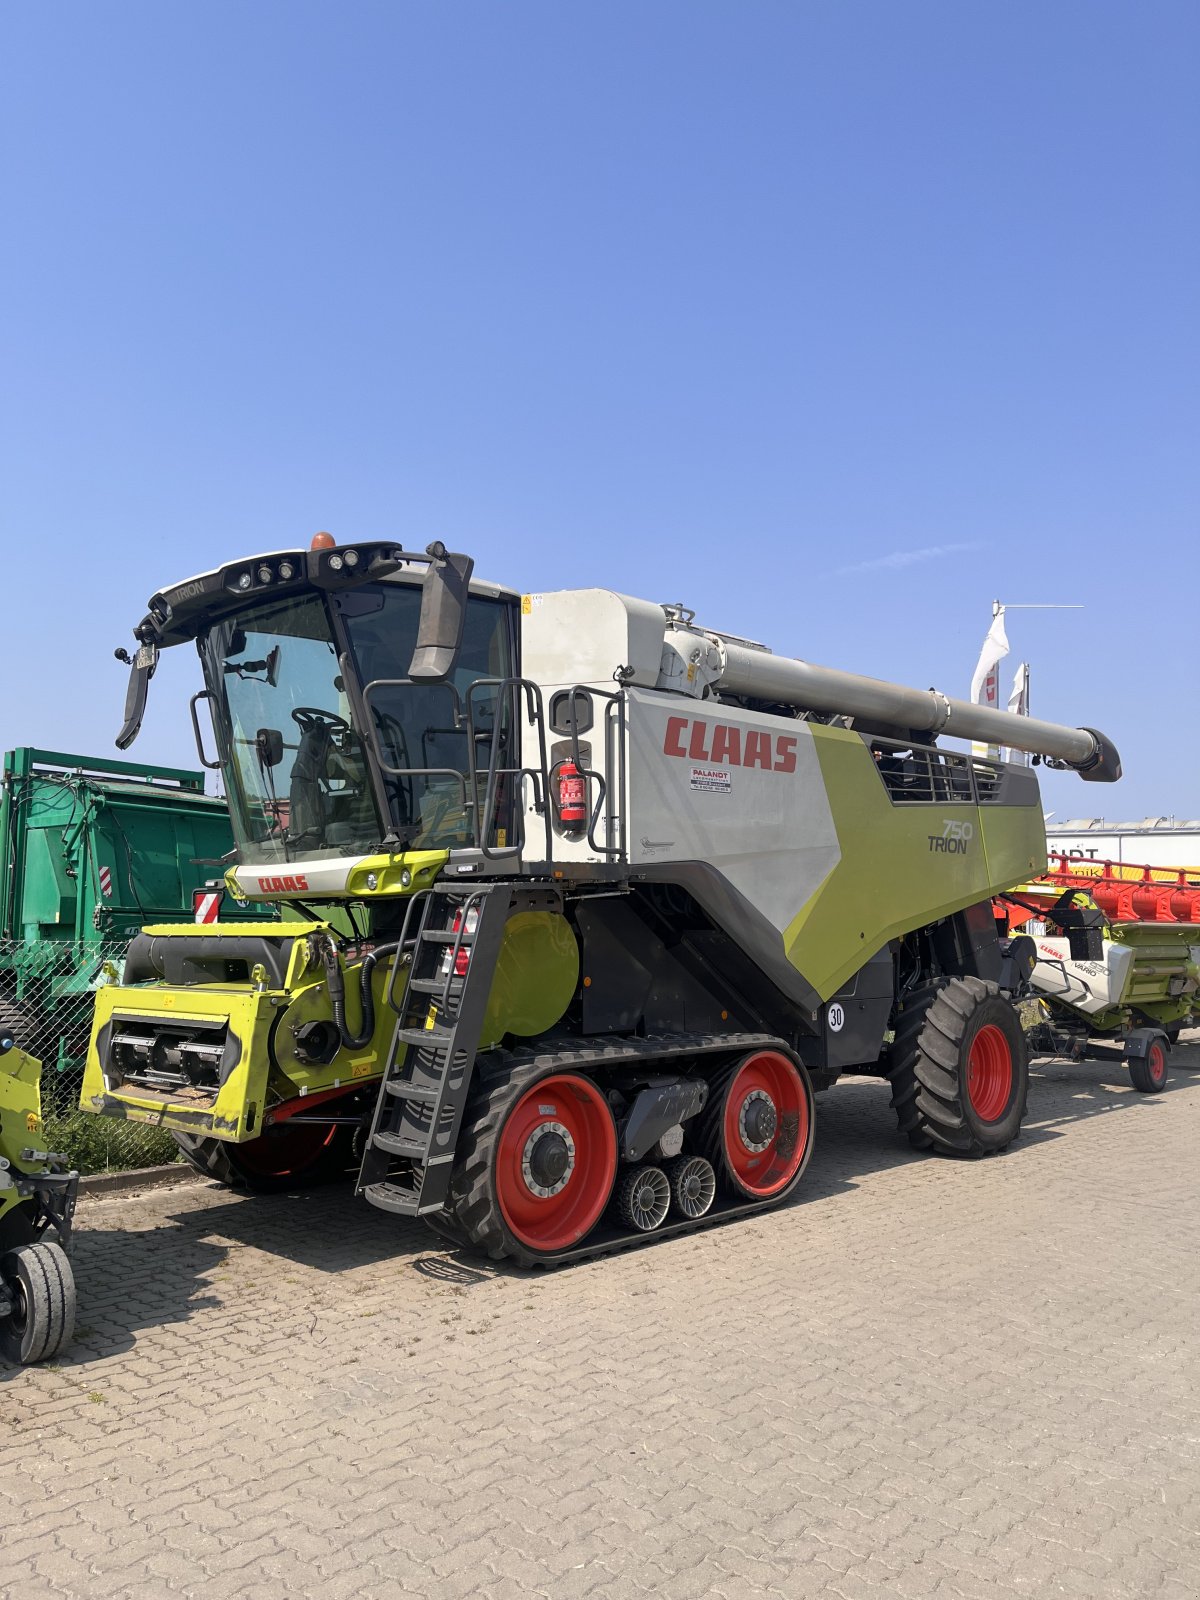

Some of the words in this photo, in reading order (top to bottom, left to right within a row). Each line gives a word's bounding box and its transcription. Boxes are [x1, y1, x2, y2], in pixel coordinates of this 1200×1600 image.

[176, 580, 205, 600] TRION
[663, 716, 798, 773] CLAAS
[693, 769, 728, 779] PALANDT
[942, 819, 973, 840] 750
[927, 835, 968, 855] TRION
[257, 875, 309, 893] CLAAS
[1040, 944, 1064, 960] CLAAS
[1074, 962, 1097, 977] VARIO
[830, 1008, 842, 1027] 30
